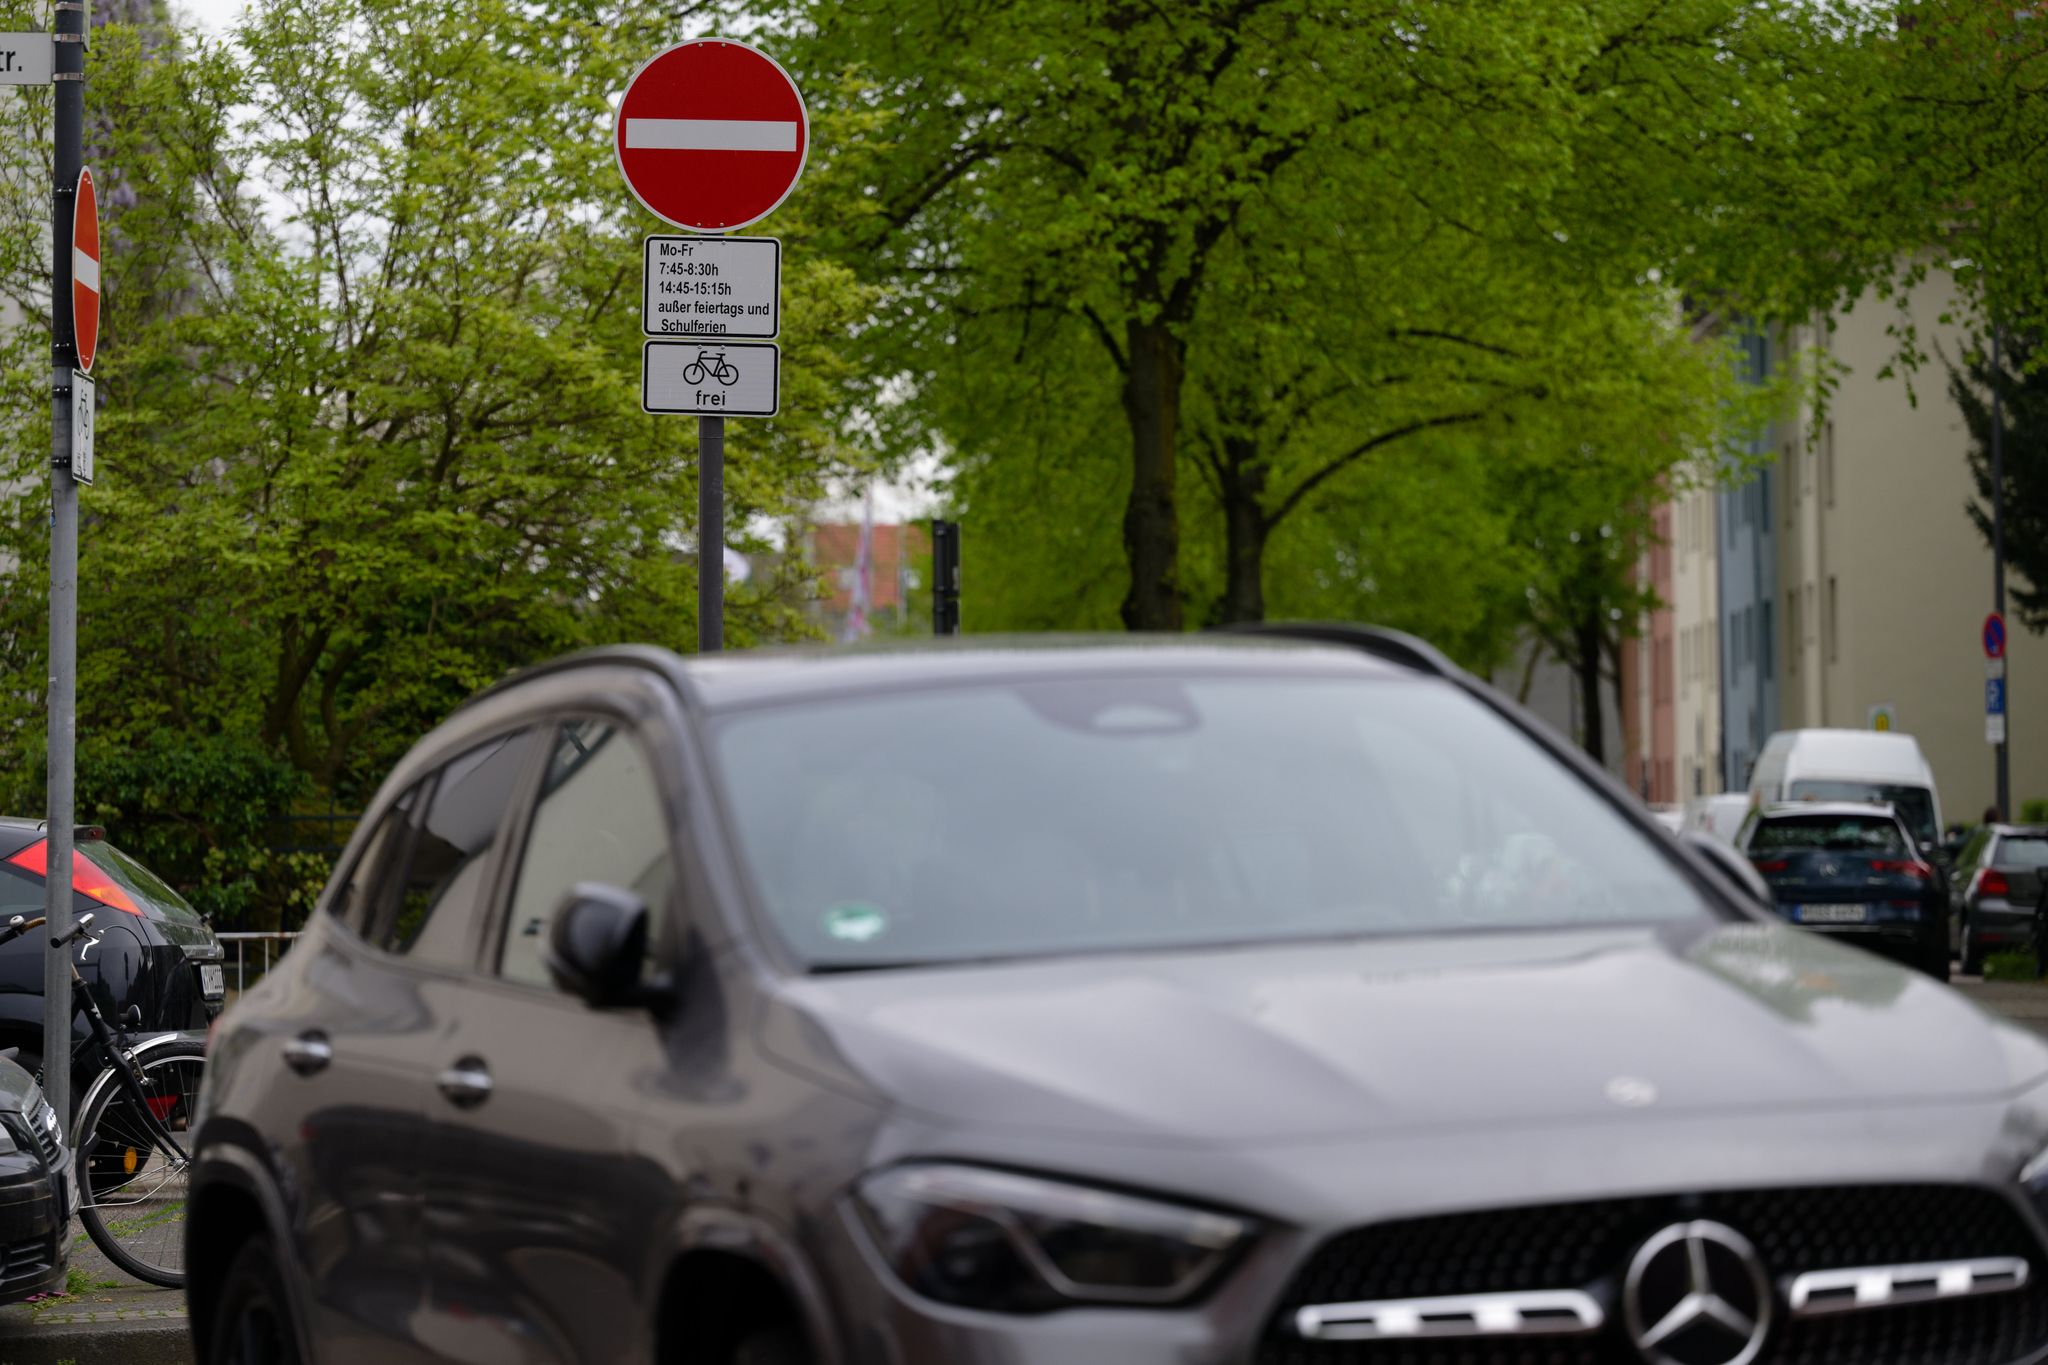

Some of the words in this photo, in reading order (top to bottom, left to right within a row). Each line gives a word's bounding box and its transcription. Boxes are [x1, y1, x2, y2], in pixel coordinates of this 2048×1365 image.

[660, 243, 694, 256] Mo-Fr
[660, 262, 719, 276] 7:45-8:30h
[659, 281, 732, 295] 14:45-15:15h
[658, 300, 691, 313] außer
[694, 301, 744, 317] feiertags
[748, 303, 770, 315] und
[661, 319, 727, 333] Schulferien
[696, 390, 726, 406] frei
